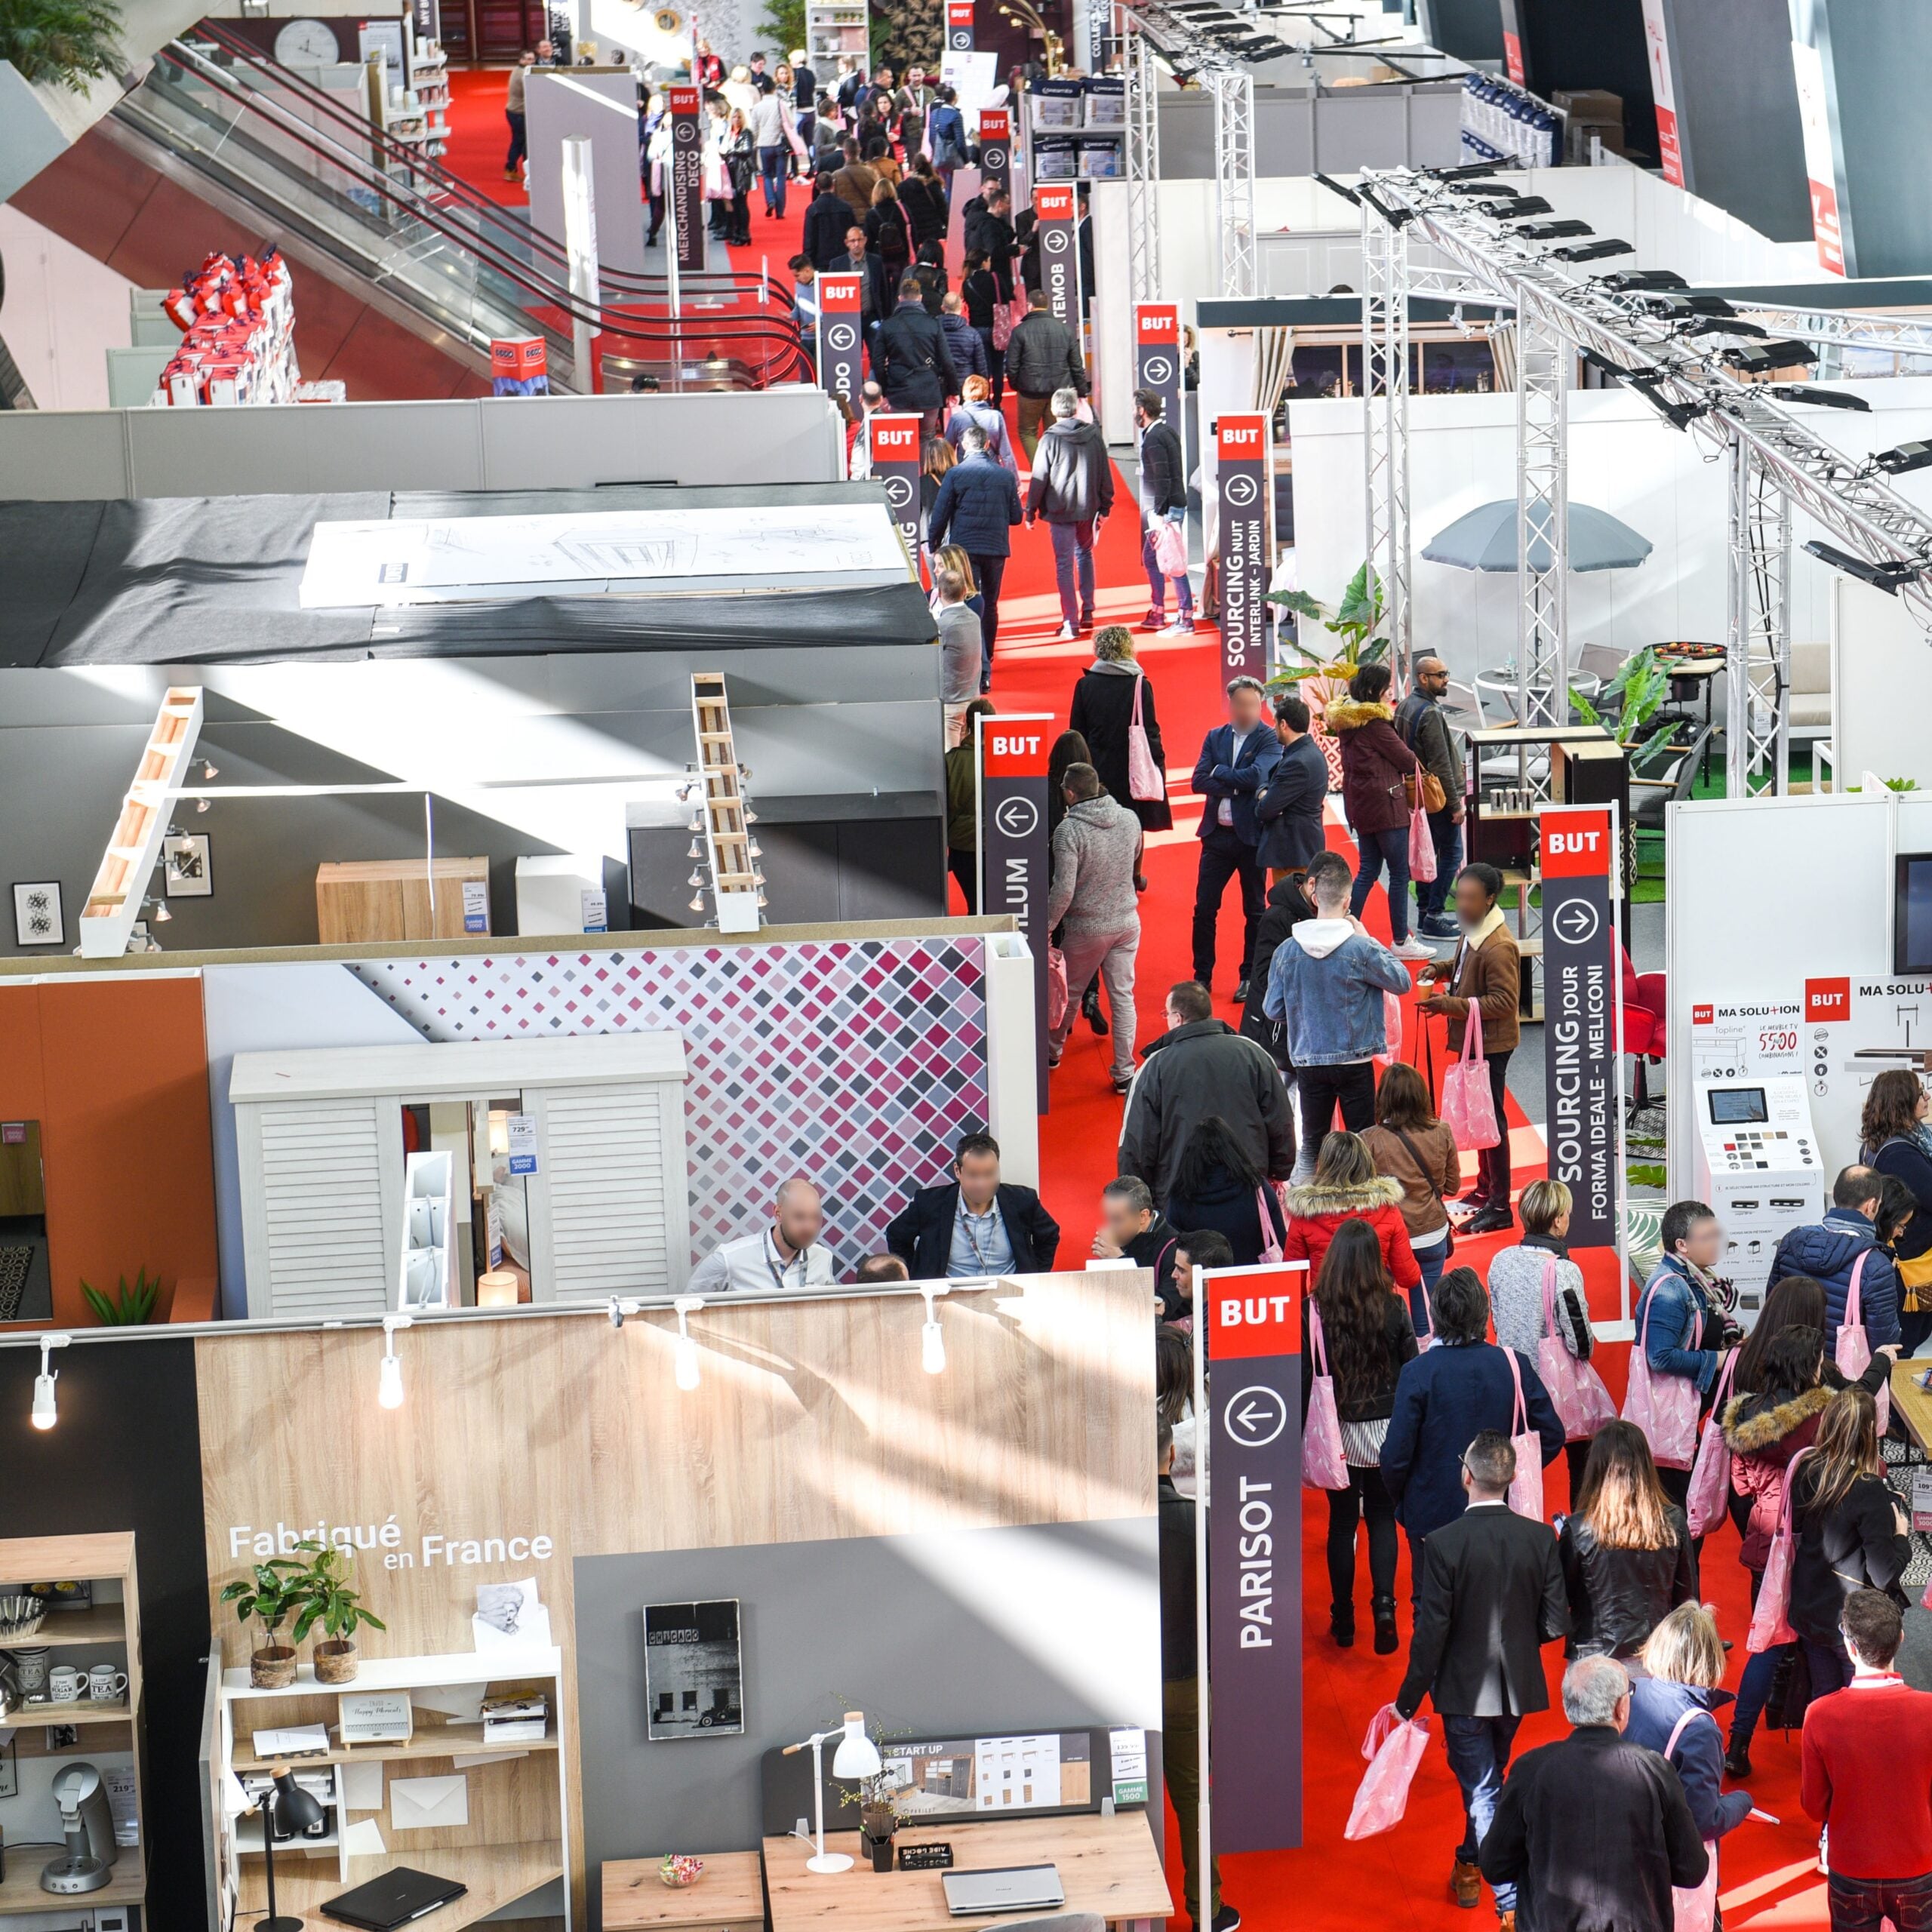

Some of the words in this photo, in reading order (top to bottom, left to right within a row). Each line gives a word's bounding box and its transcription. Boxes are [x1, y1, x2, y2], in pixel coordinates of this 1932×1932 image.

[951, 8, 971, 18] BUT
[672, 94, 696, 105] BUT
[983, 119, 1006, 130] BUT
[687, 150, 700, 188] DECO
[675, 150, 691, 262] MERCHANDISING
[1041, 196, 1068, 209] BUT
[825, 286, 857, 300] BUT
[1051, 263, 1067, 324] TEMOB
[1141, 317, 1174, 331] BUT
[877, 430, 914, 446] BUT
[1222, 429, 1259, 445] BUT
[1231, 520, 1244, 552] NUIT
[1247, 520, 1261, 566] JARDIN
[1226, 555, 1246, 667] SOURCING
[1249, 577, 1262, 647] INTERLINK
[992, 737, 1041, 755] BUT
[1548, 832, 1600, 854] BUT
[1561, 964, 1582, 1016] JOUR
[1860, 985, 1883, 997] MA
[1811, 993, 1844, 1007] BUT
[1587, 964, 1604, 1060] MELICONI
[1694, 1011, 1712, 1019] BUT
[1718, 1008, 1737, 1017] MA
[1759, 1032, 1798, 1051] 5500
[1555, 1021, 1582, 1183] SOURCING
[1589, 1078, 1607, 1146] IDEALE
[1591, 1151, 1608, 1221] FORMA
[1220, 1296, 1291, 1327] BUT
[229, 1514, 401, 1558] Fabriqué
[383, 1550, 414, 1571] en
[422, 1533, 553, 1567] France
[1239, 1475, 1272, 1649] PARISOT
[648, 1629, 700, 1645] CHICAGO
[91, 1684, 112, 1694] TEA
[354, 1707, 374, 1717] Happy
[893, 1745, 927, 1757] START
[929, 1744, 944, 1755] UP
[1118, 1786, 1143, 1795] GAMME
[1121, 1792, 1140, 1801] 1500
